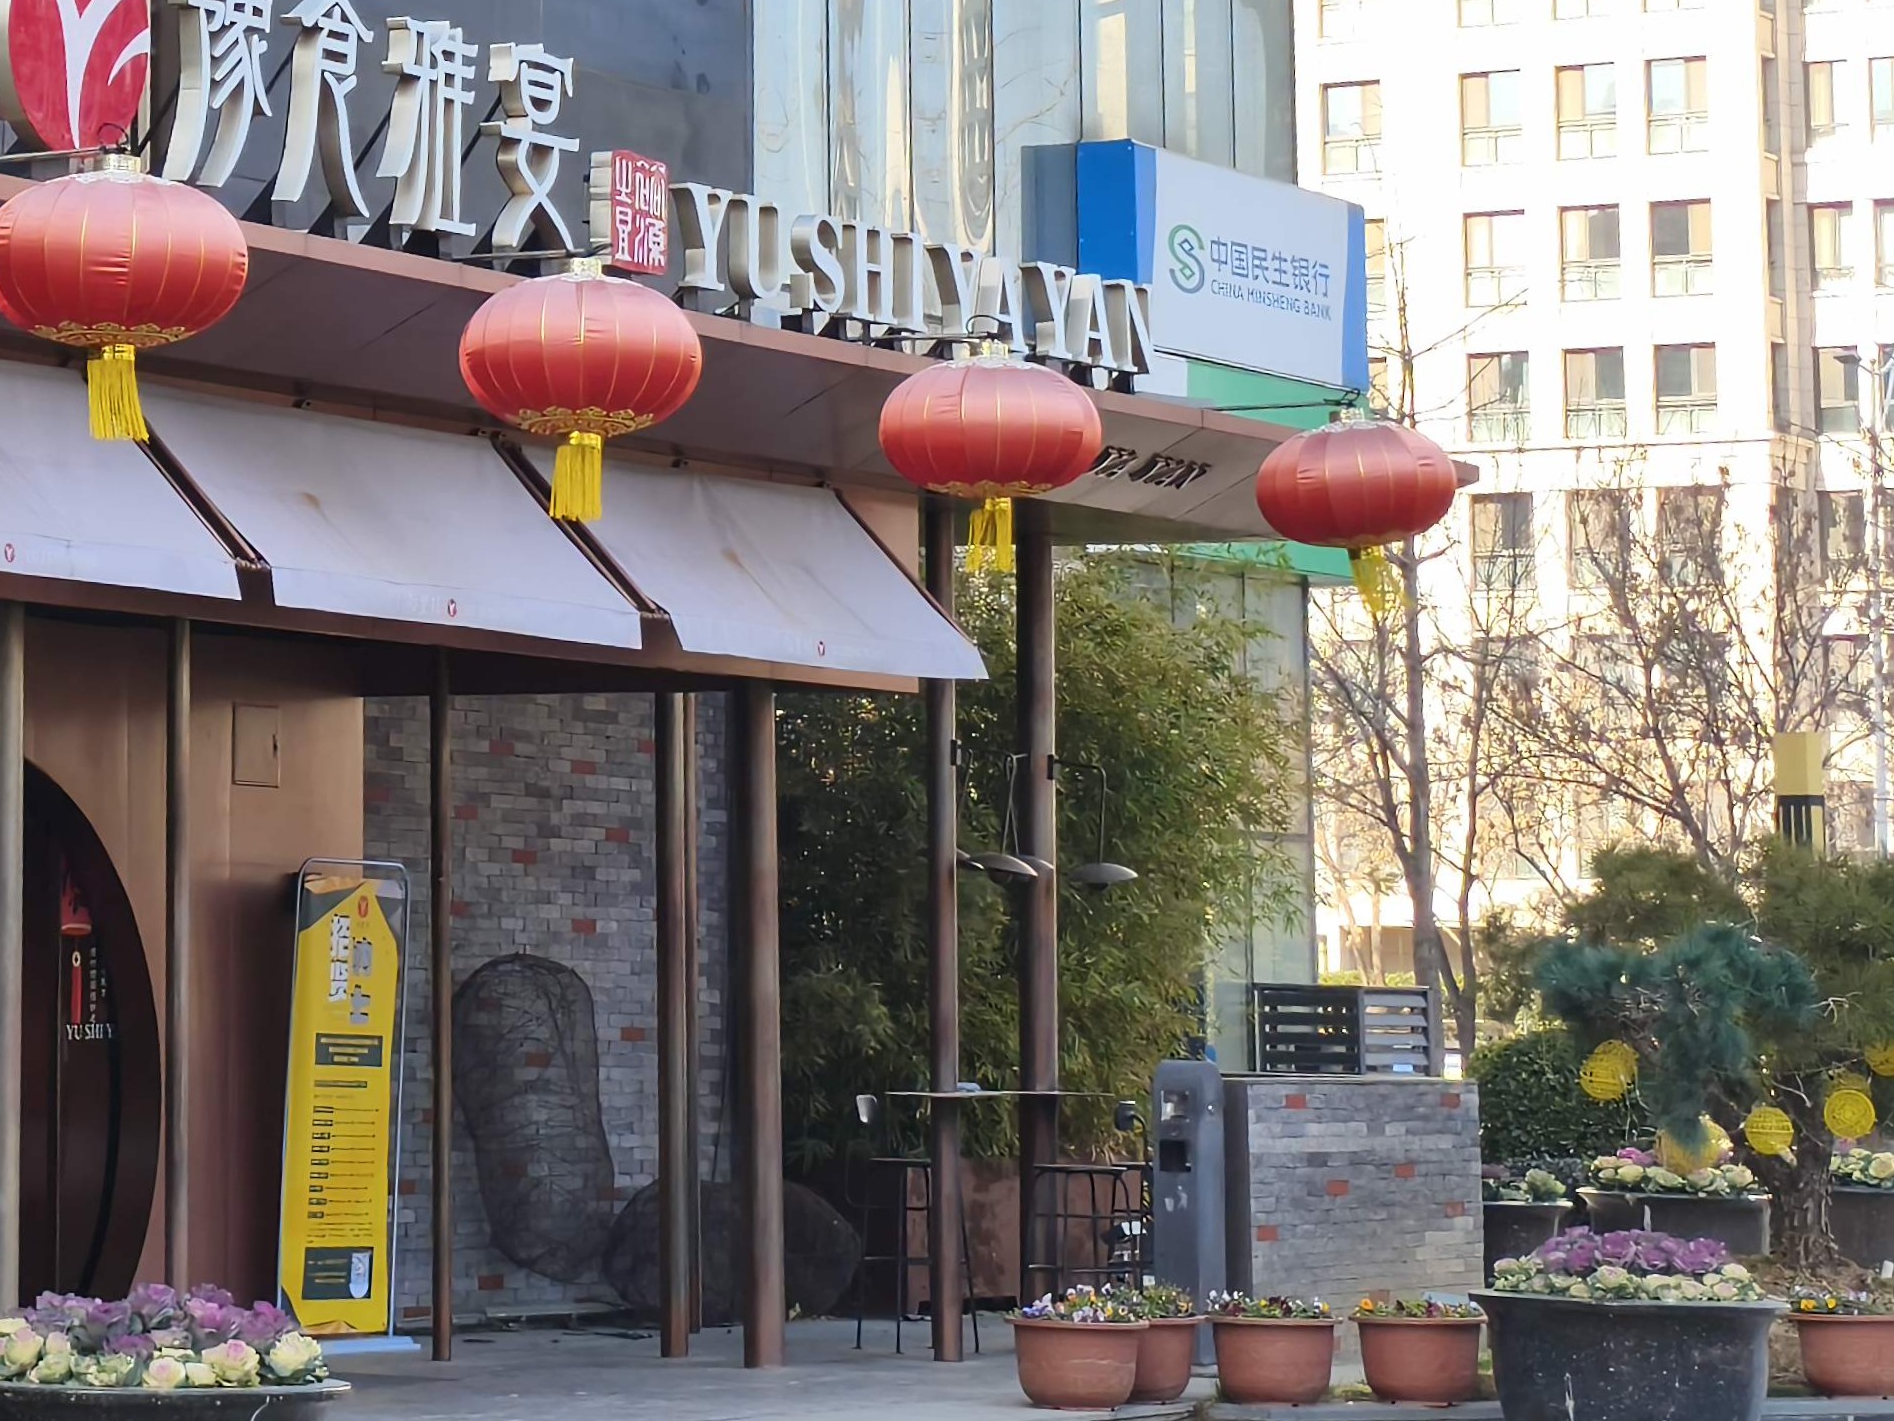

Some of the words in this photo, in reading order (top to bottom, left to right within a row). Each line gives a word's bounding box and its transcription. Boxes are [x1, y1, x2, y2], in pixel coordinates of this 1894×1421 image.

[1210, 236, 1331, 298] 中国民生银行
[1211, 279, 1244, 302] CHINA
[1247, 287, 1300, 313] MINSHENG
[1304, 300, 1332, 322] BANK
